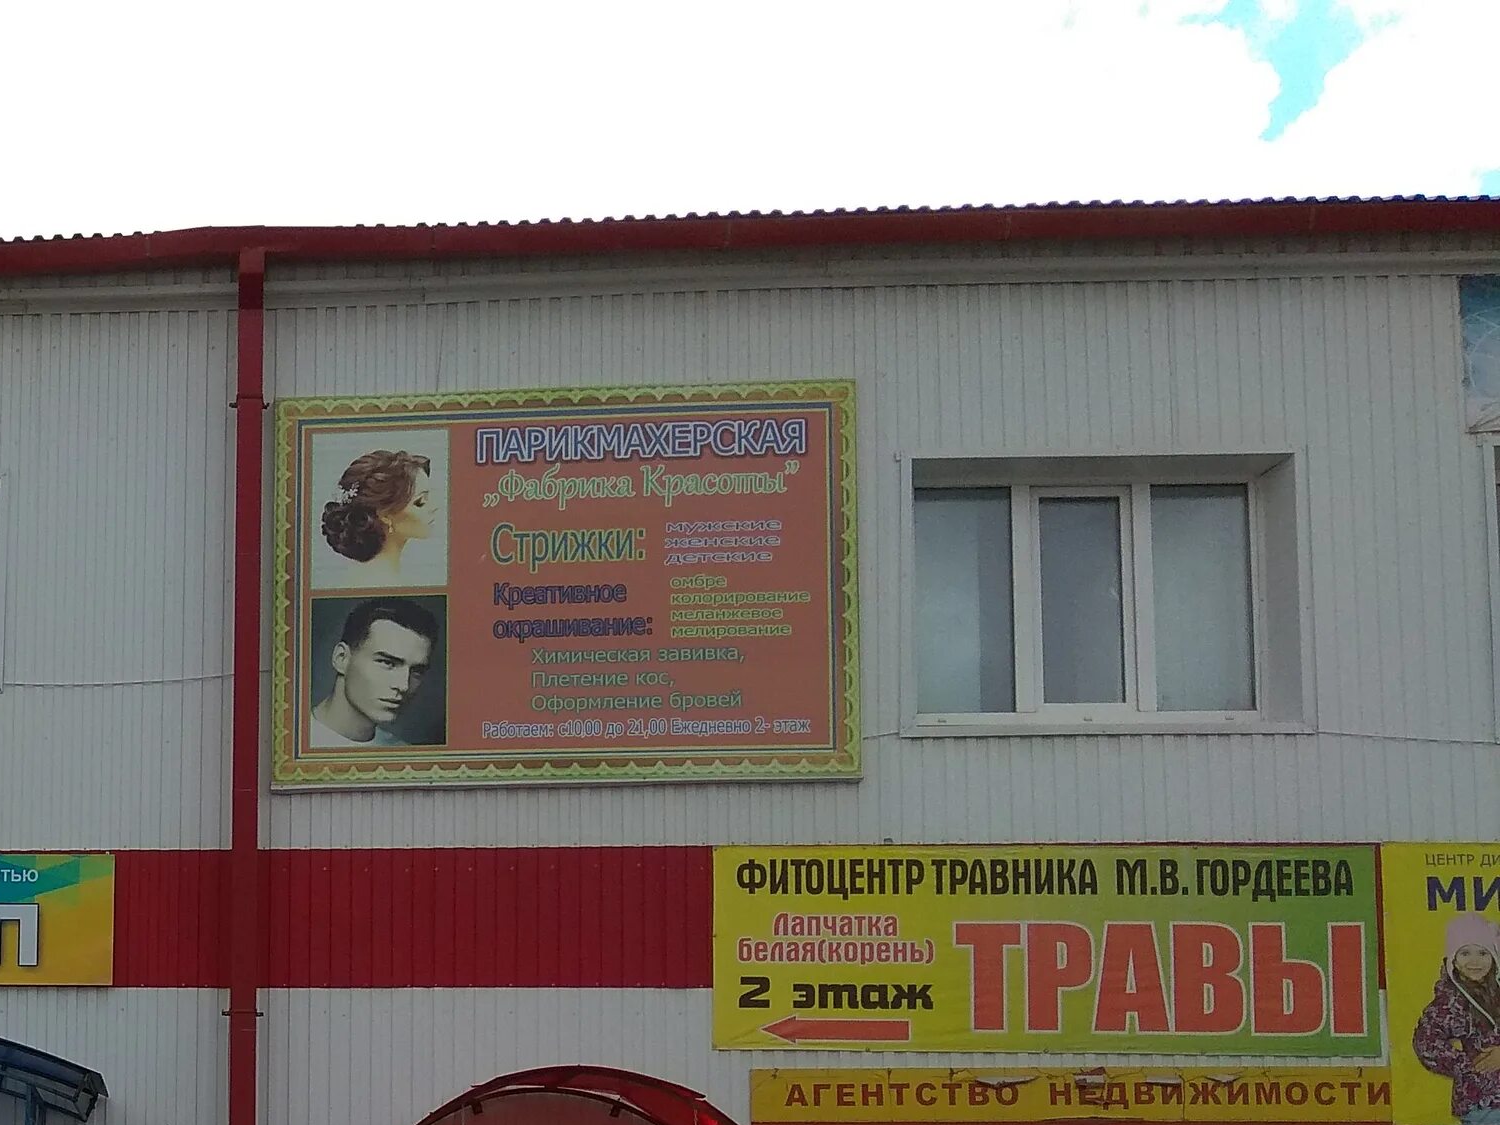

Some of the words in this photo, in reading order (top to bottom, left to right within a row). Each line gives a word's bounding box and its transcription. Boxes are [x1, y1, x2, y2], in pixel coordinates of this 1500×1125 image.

[475, 418, 806, 463] ПАРИКМАХЕРСКАЯ
[665, 519, 781, 531] мужские
[492, 523, 646, 574] Стрижки:
[665, 535, 780, 548] женские
[665, 551, 772, 565] детские
[670, 575, 726, 589] омбре
[494, 583, 627, 610] Креативное
[671, 591, 810, 606] колорирование
[671, 608, 782, 621] меланжевое
[493, 616, 652, 642] окрашивание:
[671, 624, 791, 639] мелирование
[532, 648, 650, 664] Химическая
[658, 647, 744, 662] завивка,
[532, 671, 627, 687] Плетение
[636, 670, 674, 687] кос,
[531, 695, 662, 712] Оформление
[670, 691, 742, 709] бровей
[1425, 854, 1475, 867] ЦЕНТР
[737, 858, 925, 898] ФИТОЦЕНТР
[932, 858, 1098, 897] ТРАВНИКА
[1116, 858, 1188, 895] М.В.
[1196, 859, 1353, 902] ГОРДЕЕВА
[773, 912, 897, 939] Лапчатка
[953, 920, 1368, 1036] ТРАВЫ
[739, 976, 771, 1010] 2
[792, 983, 934, 1011] этаж
[785, 1081, 1019, 1107] АГЕНТСТВО
[1049, 1080, 1391, 1109] НЕДВИЖИМОСТИ
